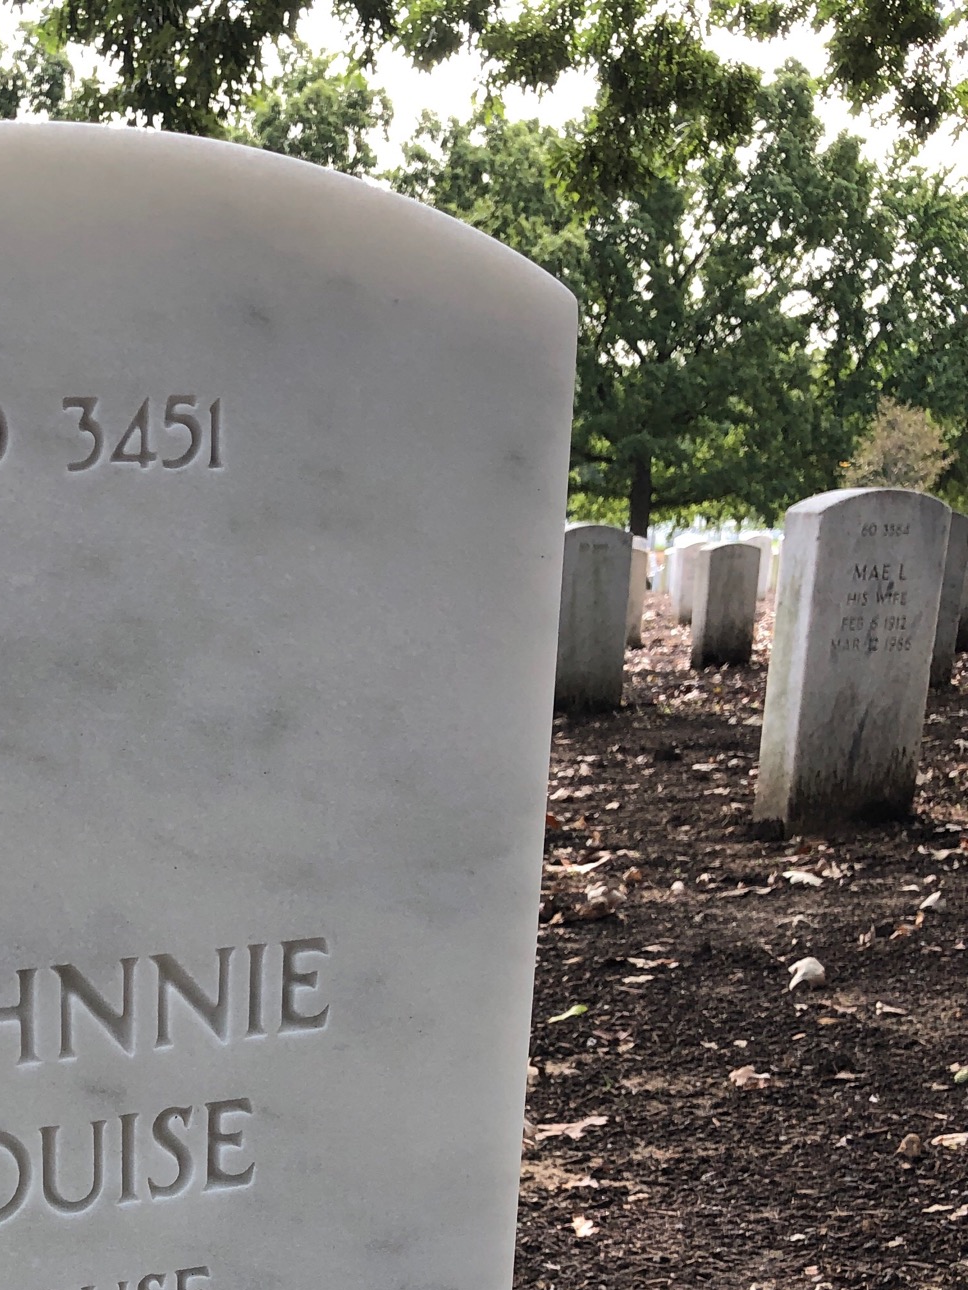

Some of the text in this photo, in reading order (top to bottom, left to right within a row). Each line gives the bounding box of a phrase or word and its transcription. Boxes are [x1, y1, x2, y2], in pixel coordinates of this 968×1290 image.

[61, 393, 225, 472] 3451
[852, 562, 908, 581] MAE L
[846, 590, 869, 607] HIS
